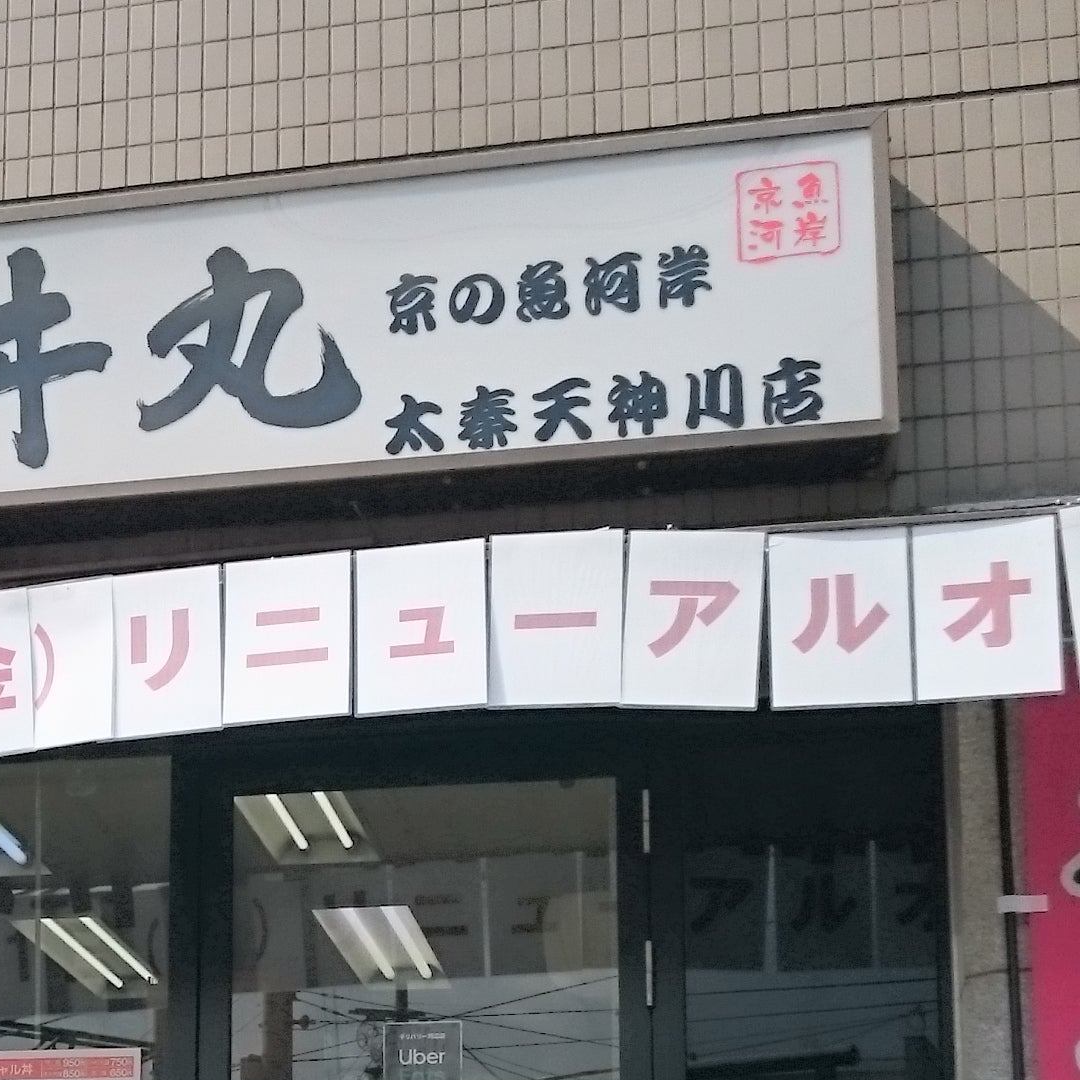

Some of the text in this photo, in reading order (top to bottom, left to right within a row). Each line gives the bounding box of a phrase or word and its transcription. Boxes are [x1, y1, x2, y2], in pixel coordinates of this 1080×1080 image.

[385, 244, 714, 335] 京の魚河岸
[385, 357, 824, 455] 太秦天神川店
[399, 1049, 447, 1066] Uber
